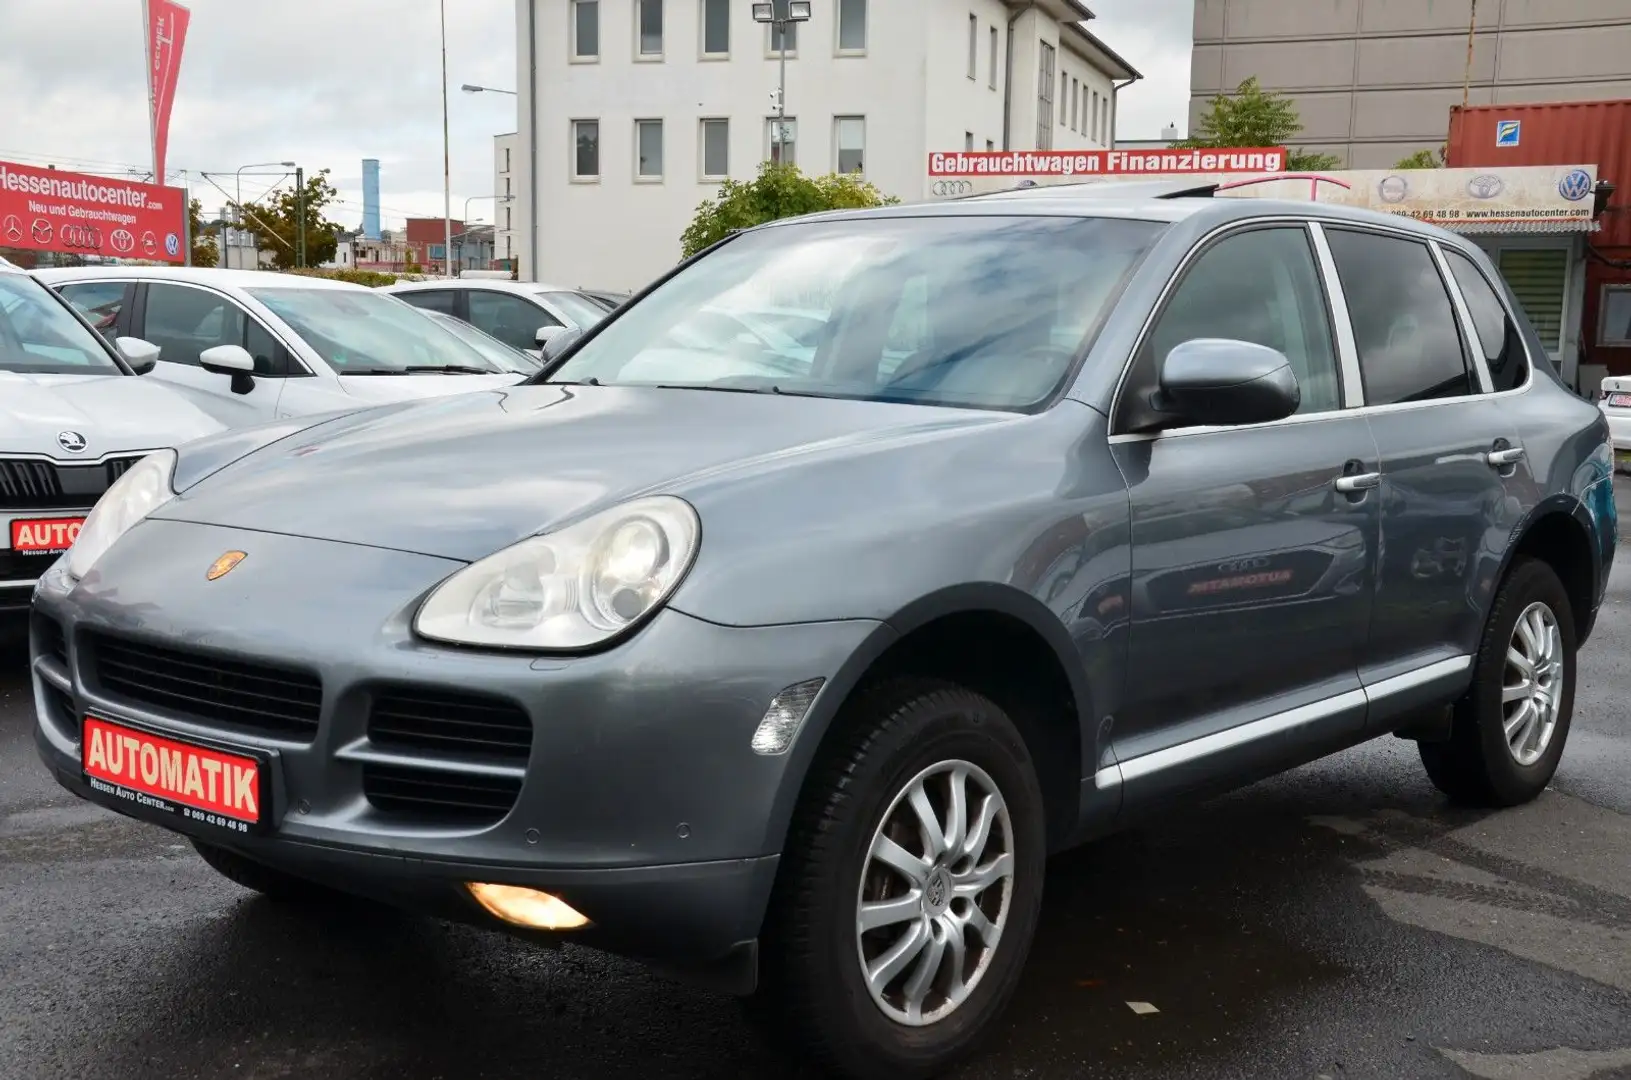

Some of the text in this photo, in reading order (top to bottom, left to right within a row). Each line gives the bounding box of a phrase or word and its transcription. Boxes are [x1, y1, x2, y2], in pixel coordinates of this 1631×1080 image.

[931, 150, 1281, 175] Gebrauchtwagen Finanzierung
[28, 200, 137, 225] Neu und Gebrauchtwagen
[1436, 210, 1447, 219] 48
[1466, 208, 1589, 219] www.hessenautocenter.com
[88, 727, 257, 814] AUTOMATIK
[115, 785, 135, 801] AUTO
[206, 814, 216, 824] 42
